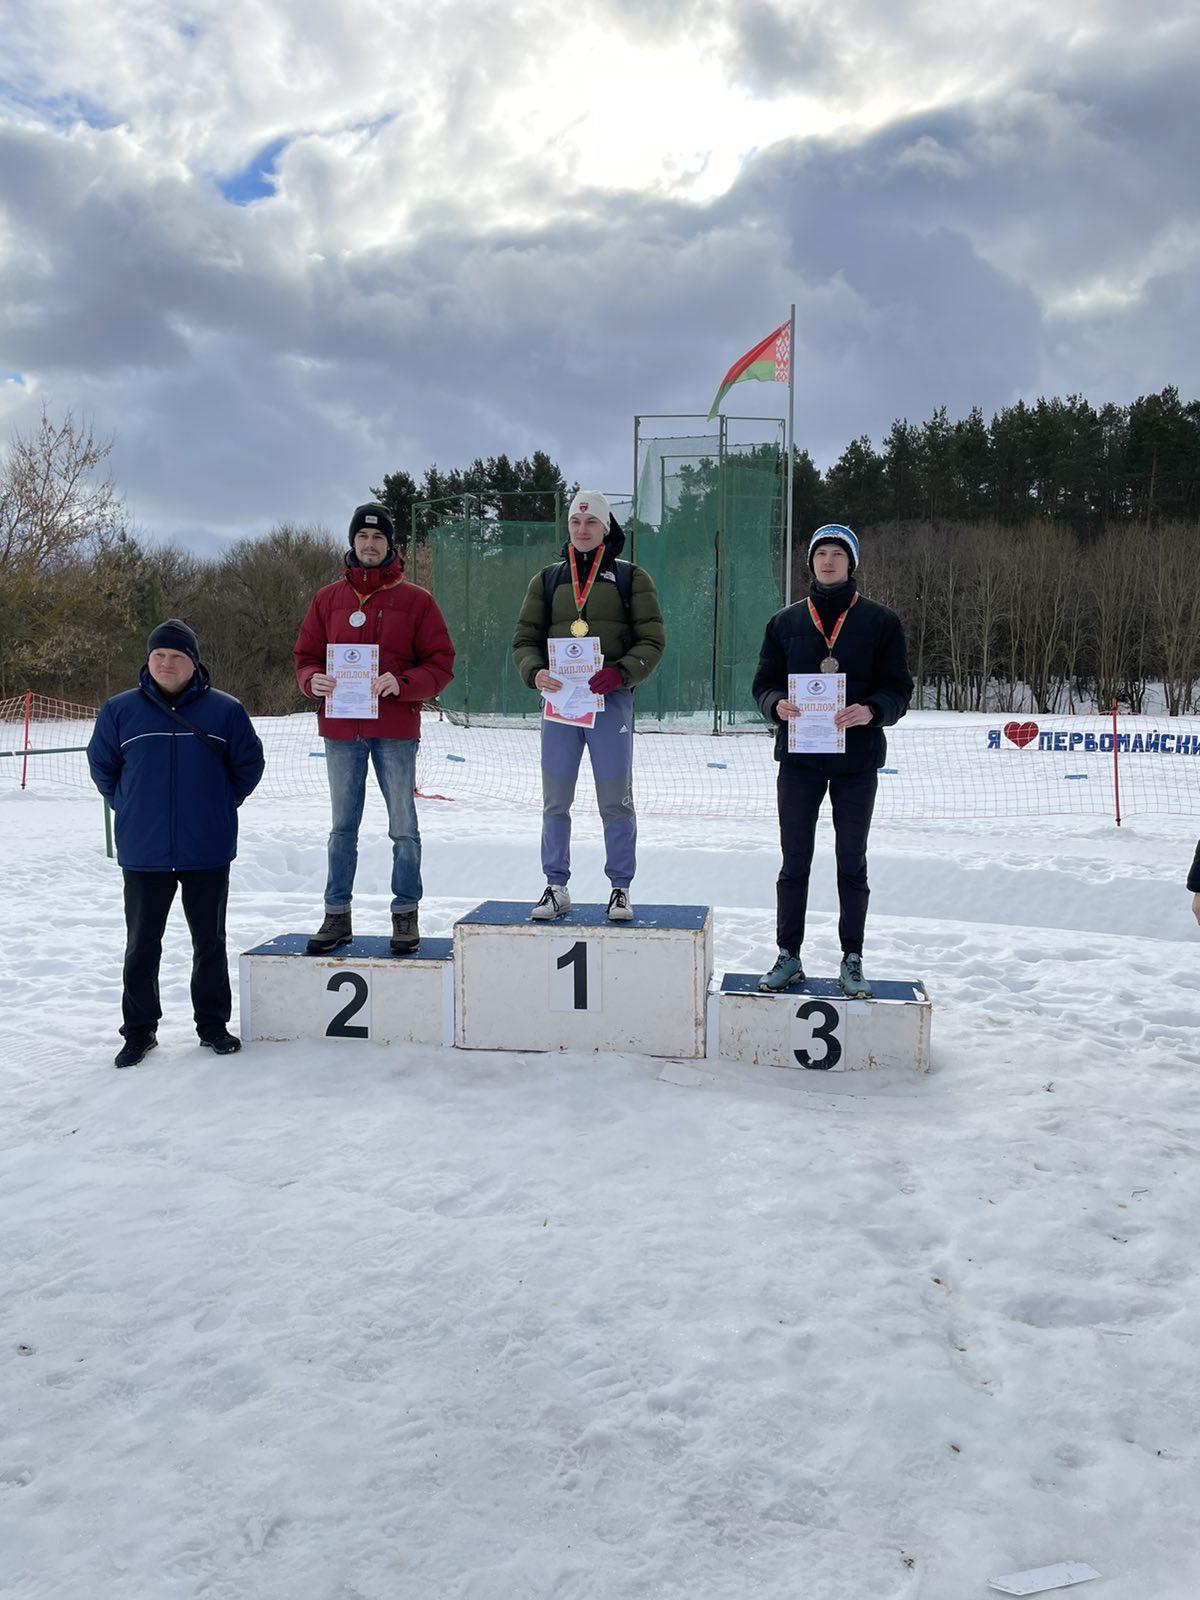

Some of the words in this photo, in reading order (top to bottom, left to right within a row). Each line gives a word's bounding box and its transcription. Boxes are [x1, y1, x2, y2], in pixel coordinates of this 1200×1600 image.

[335, 671, 370, 679] ДИПЛОМ
[558, 664, 594, 675] ДИПЛОМ
[799, 703, 836, 712] ДИПЛОМ
[987, 729, 1000, 748] Я
[557, 941, 588, 1010] 1
[325, 971, 369, 1038] 2
[794, 1000, 843, 1071] 3
